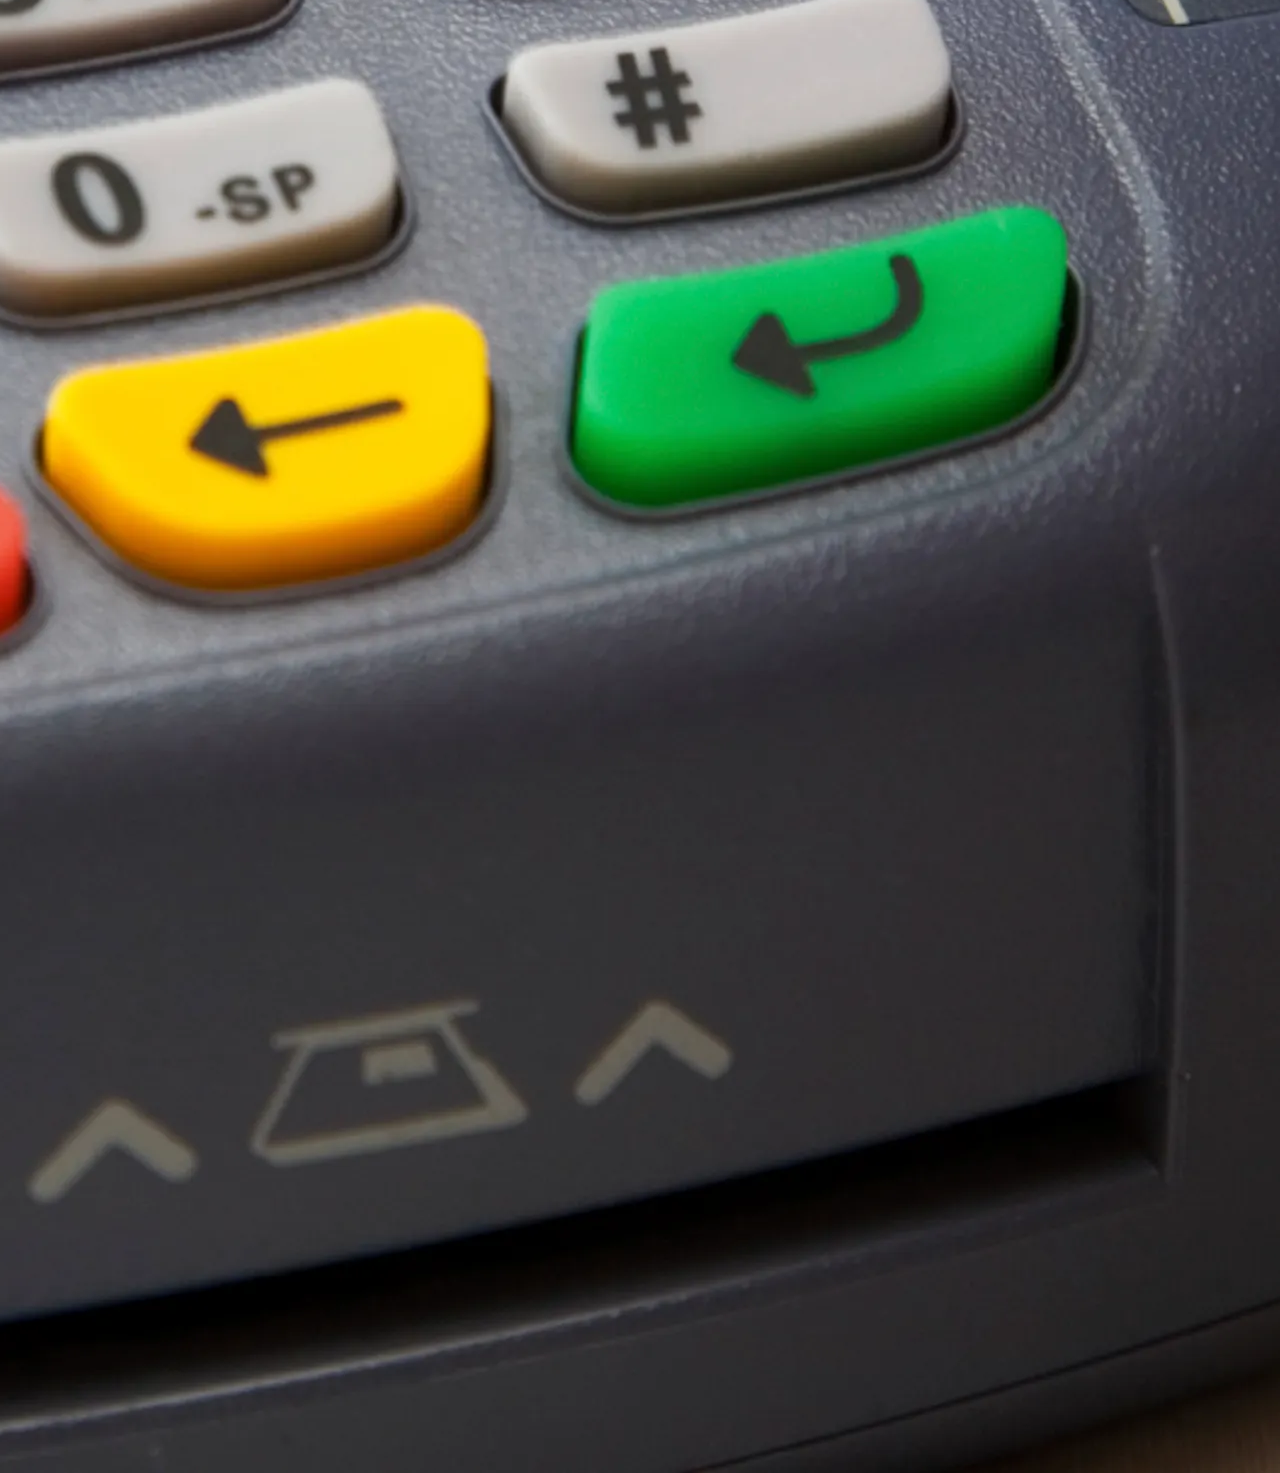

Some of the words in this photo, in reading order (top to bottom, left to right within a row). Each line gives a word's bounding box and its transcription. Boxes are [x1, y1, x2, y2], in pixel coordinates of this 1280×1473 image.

[605, 47, 702, 149] #
[51, 152, 144, 246] 0
[195, 163, 315, 225] -SP
